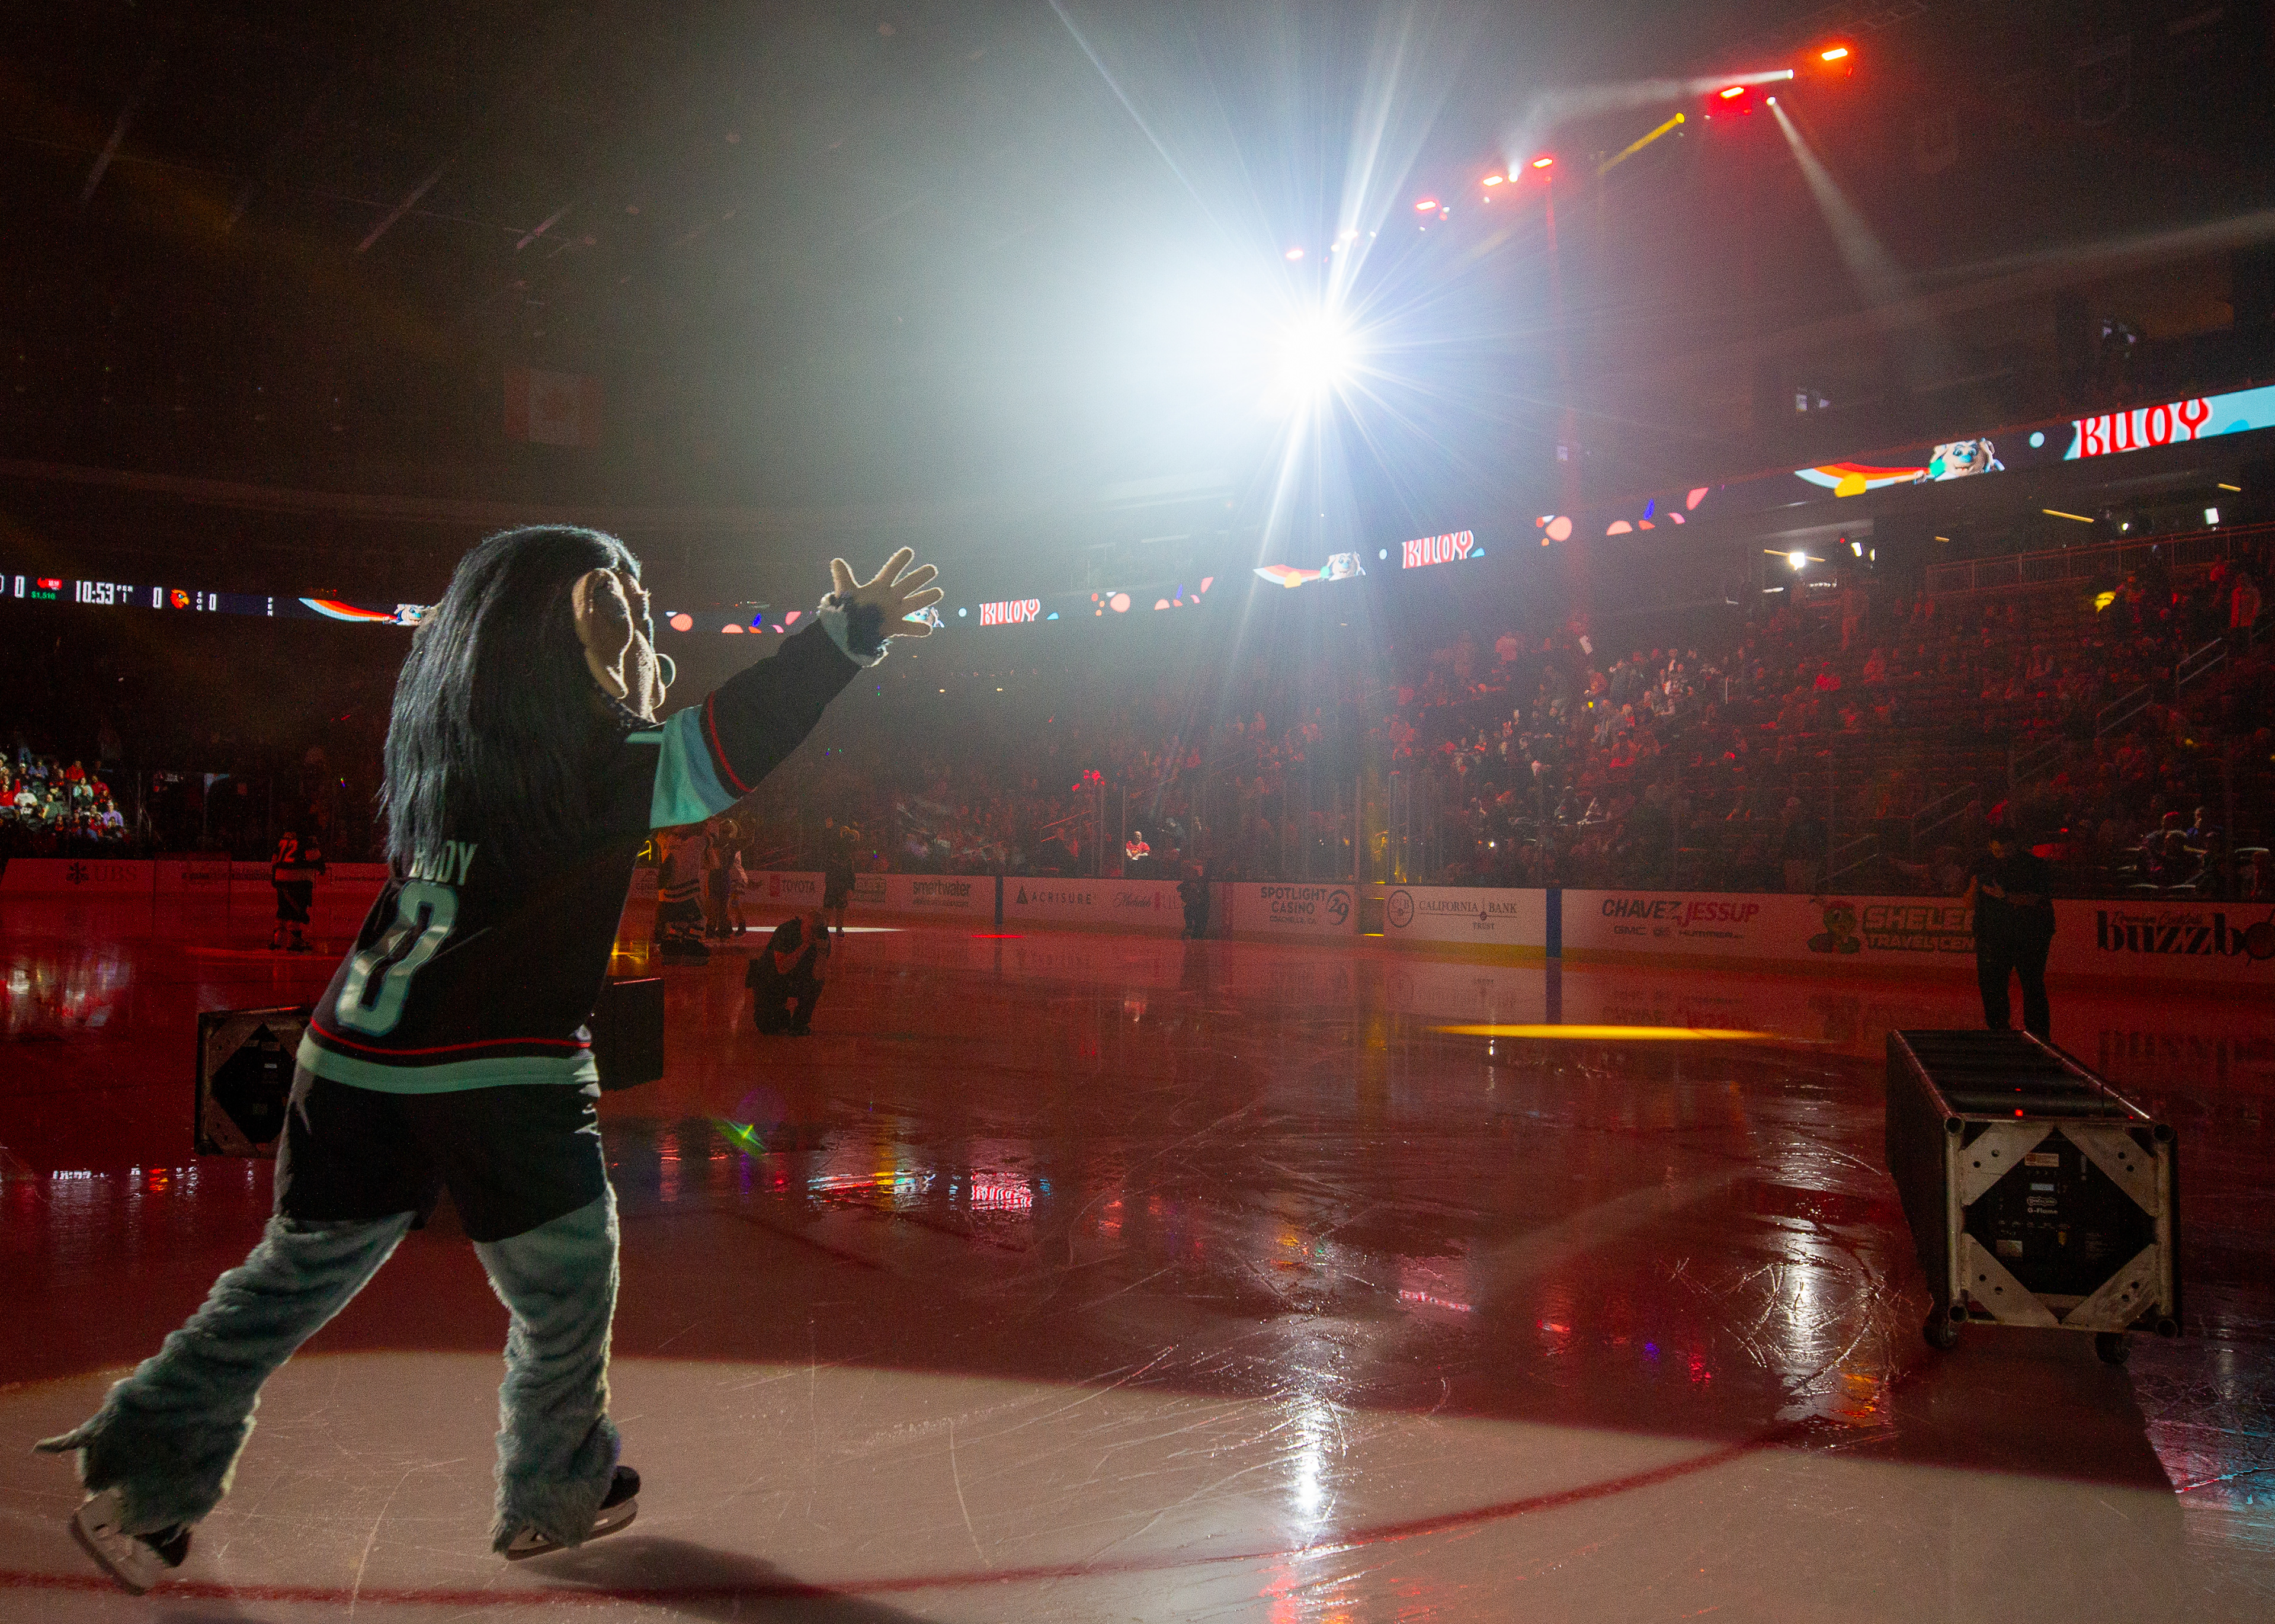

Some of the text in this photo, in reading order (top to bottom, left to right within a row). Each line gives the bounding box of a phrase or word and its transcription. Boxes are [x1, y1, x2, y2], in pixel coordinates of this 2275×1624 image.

[2078, 397, 2213, 459] BUOY
[1402, 530, 1475, 569] BUOY
[14, 575, 25, 598] 0
[76, 580, 114, 605] 10:53
[153, 587, 163, 609] 0
[209, 593, 216, 611] 0
[93, 866, 137, 882] UBS
[781, 879, 815, 893] TOYOTA
[913, 880, 972, 896] smartwater
[1260, 886, 1328, 901] SPOTLIGHT
[1031, 891, 1092, 905] ACRISURE
[1271, 901, 1315, 915] CASINO
[1418, 901, 1517, 914] CALIFORNIA BANK
[1601, 898, 1760, 927] CHAVEZ JESSUP
[1614, 925, 1646, 936] GMC
